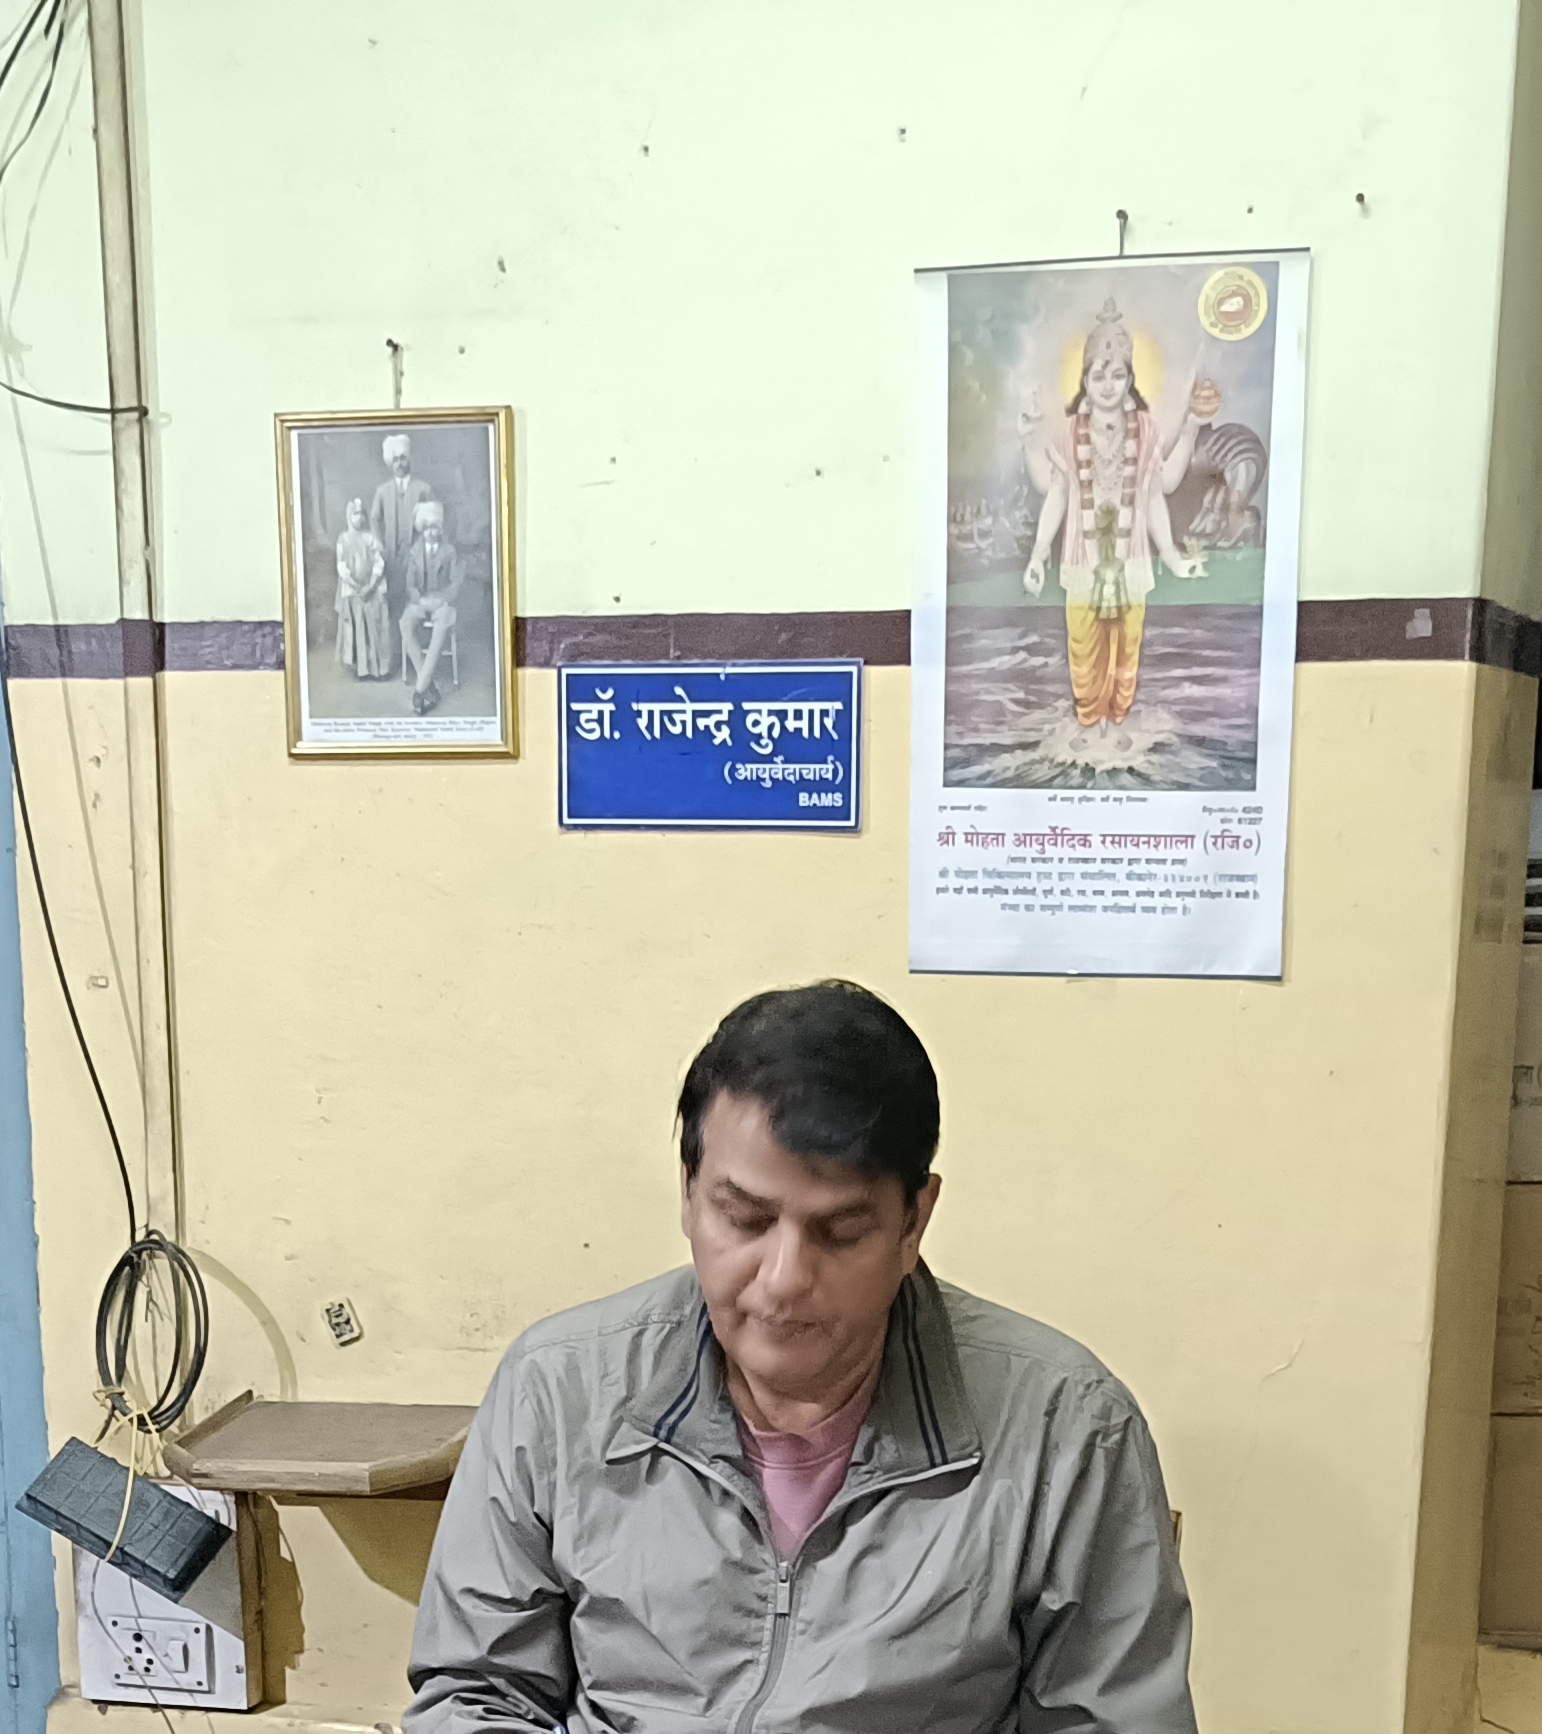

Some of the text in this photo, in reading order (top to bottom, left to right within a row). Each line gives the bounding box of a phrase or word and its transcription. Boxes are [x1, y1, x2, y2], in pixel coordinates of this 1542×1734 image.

[570, 686, 843, 754] डॉ. राजेन्द्र कुमार
[723, 756, 844, 788] (आयुर्वेदाचार्य)
[798, 792, 844, 807] BAMS
[937, 825, 957, 847] श्री
[963, 824, 1006, 850] मोहता
[1012, 825, 1093, 855] आयुर्वेदिक
[1099, 833, 1196, 852] रसायनशाला
